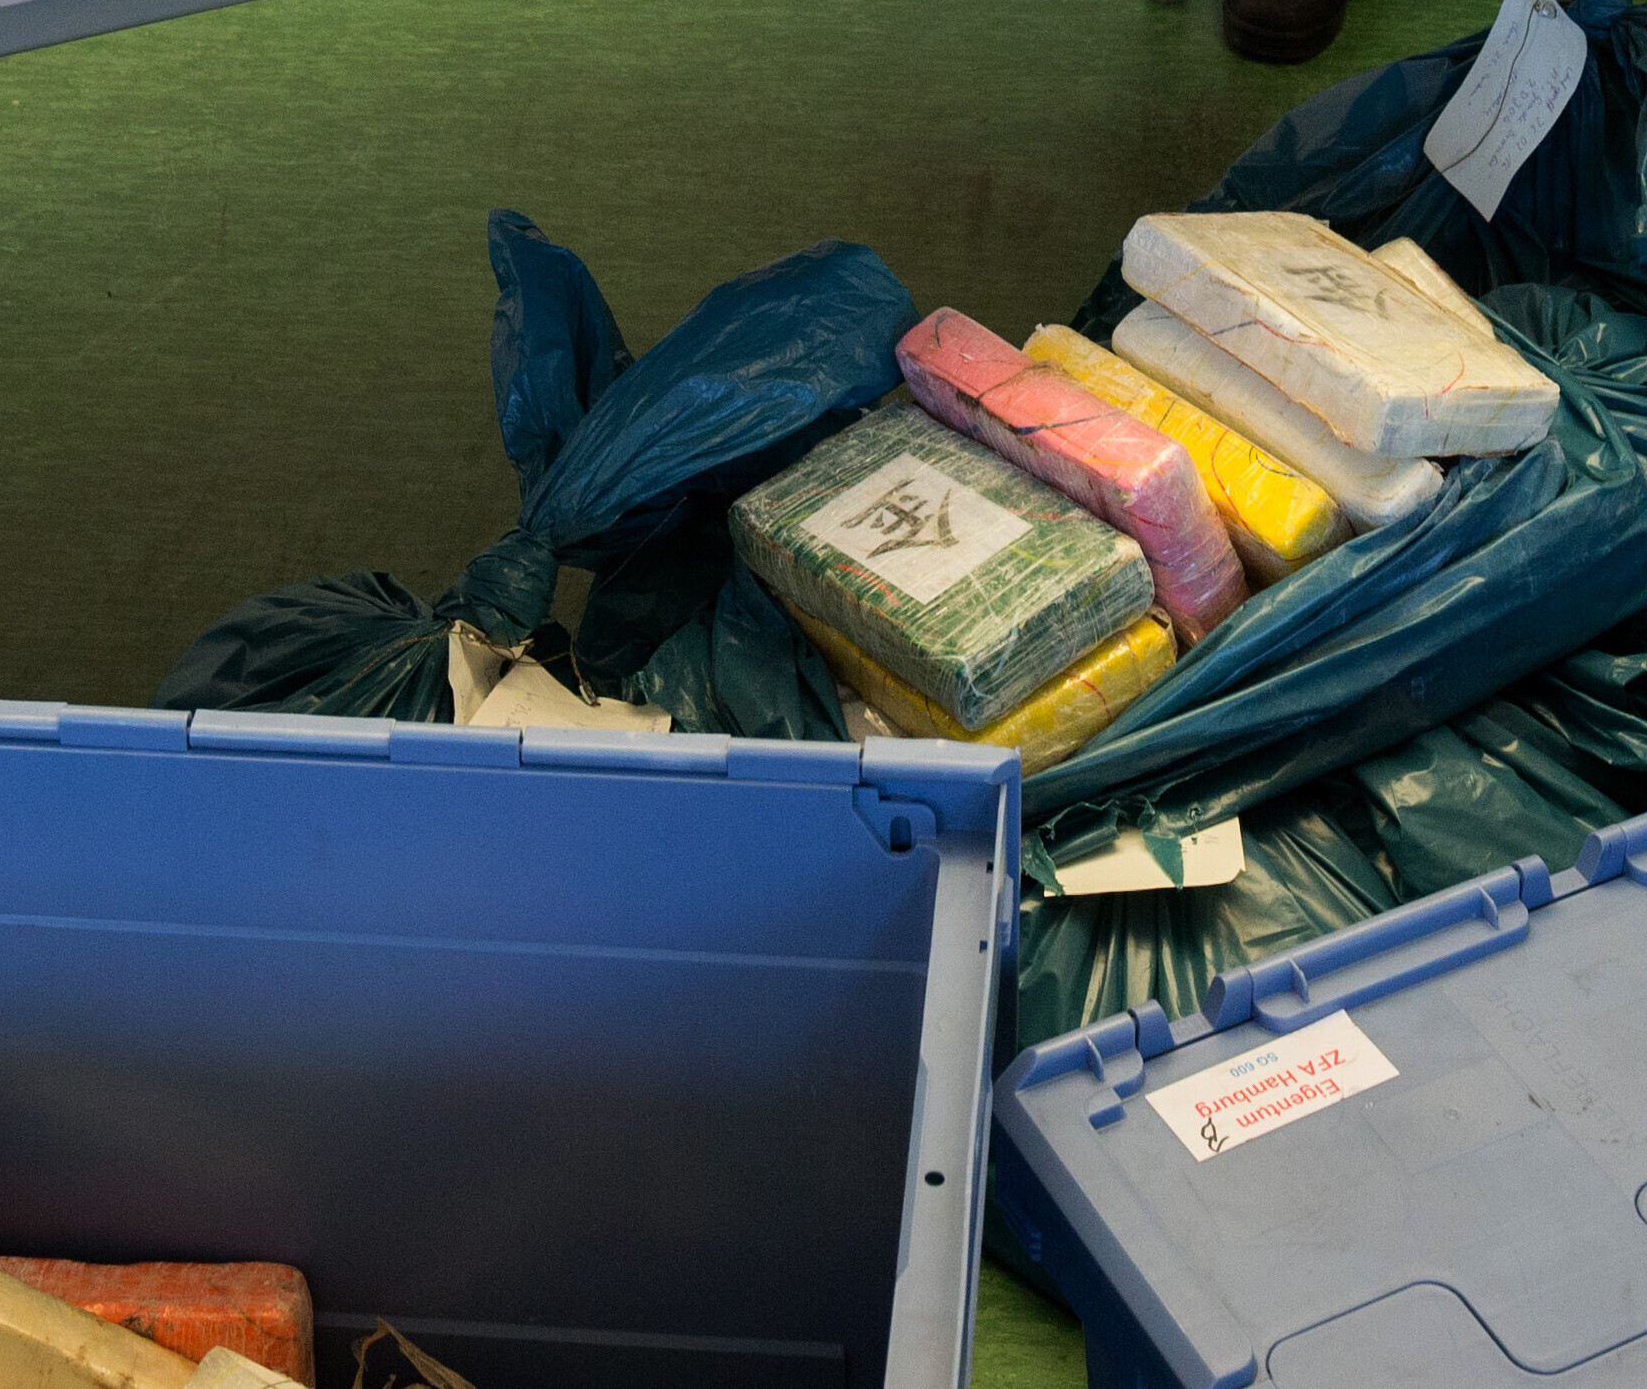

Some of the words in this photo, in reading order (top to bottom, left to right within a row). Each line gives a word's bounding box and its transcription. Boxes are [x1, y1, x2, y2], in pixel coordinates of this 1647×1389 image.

[1283, 262, 1391, 313] 金
[843, 479, 958, 559] 金
[1230, 1063, 1255, 1078] 600
[1256, 1052, 1279, 1068] SG
[1297, 1049, 1347, 1076] ZFA
[1195, 1070, 1298, 1118] Hamburg
[1236, 1078, 1342, 1129] Eigentum
